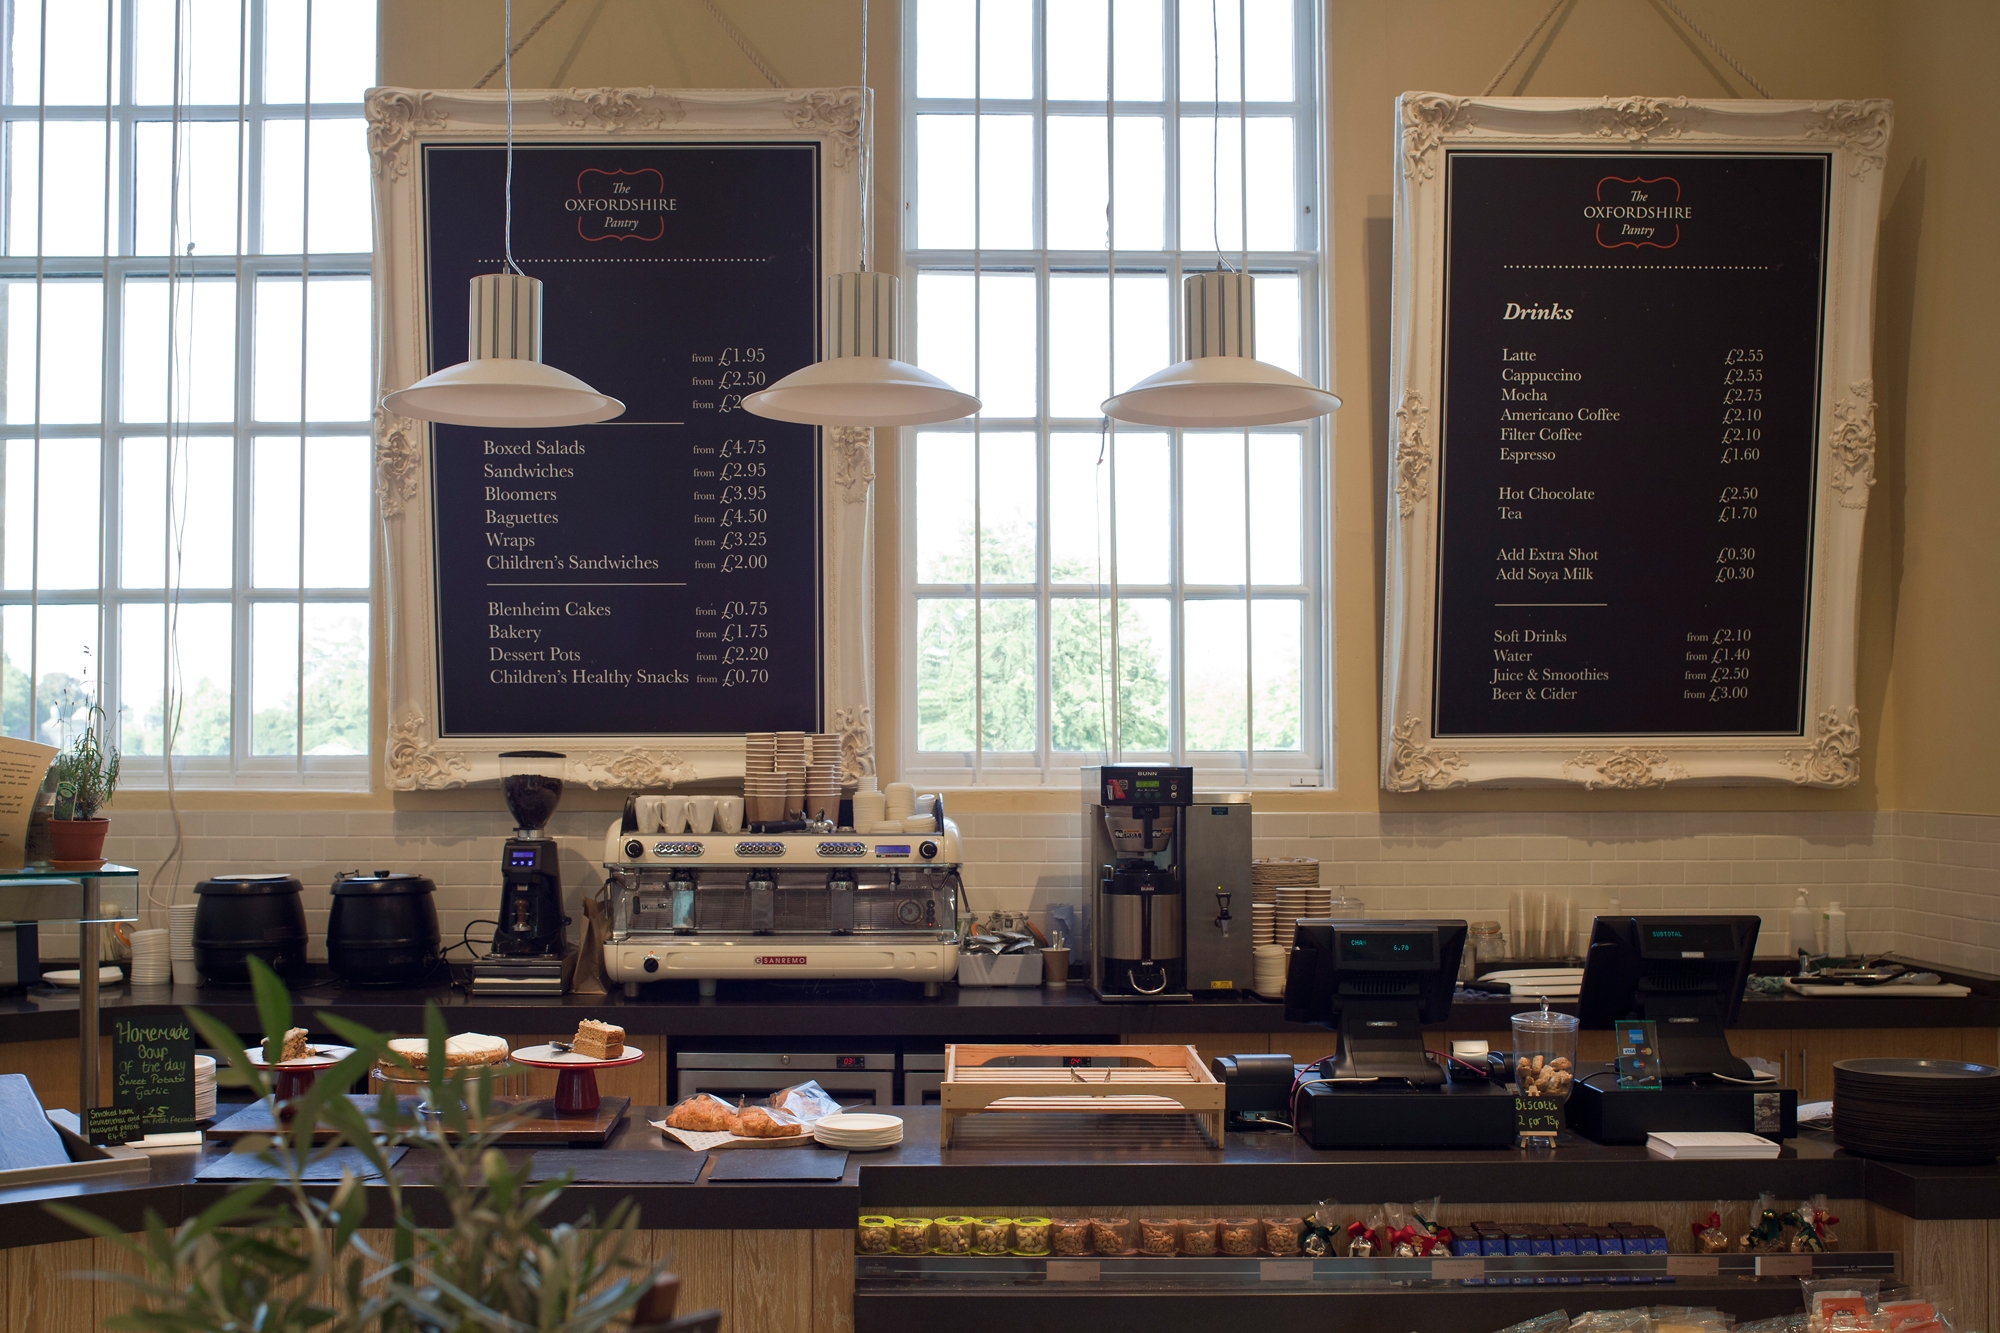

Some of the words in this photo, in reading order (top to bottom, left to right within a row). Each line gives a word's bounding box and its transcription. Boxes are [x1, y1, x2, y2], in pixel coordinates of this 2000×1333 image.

[613, 183, 630, 193] The
[1631, 191, 1648, 201] The
[565, 199, 676, 211] OXFORDSHIRE
[1584, 207, 1691, 218] OXFORDSHIRE
[604, 217, 638, 231] Pantry
[1622, 224, 1654, 238] Pantry
[1503, 303, 1574, 320] Drinks
[692, 354, 713, 362] from
[719, 348, 765, 366] £1.95
[1503, 349, 1536, 361] Latte
[1725, 349, 1763, 365] £2.55
[693, 377, 713, 385] from
[719, 371, 766, 390] £2.50
[1502, 368, 1581, 384] Cappuccino
[1724, 369, 1762, 384] £2.55
[693, 400, 713, 408] from
[1502, 388, 1547, 400] Mocha
[1723, 389, 1762, 404] £2.75
[1501, 408, 1573, 420] Americano
[1578, 408, 1620, 420] Coffee
[1723, 408, 1761, 424] £2.10
[1501, 428, 1535, 440] Filter
[1540, 428, 1582, 440] Coffee
[1722, 428, 1760, 444] £2.10
[484, 441, 531, 454] Boxed
[537, 440, 585, 454] Salads
[694, 445, 714, 453] from
[720, 440, 765, 457] £4.75
[1501, 448, 1555, 464] Espresso
[1721, 448, 1759, 463] £1.60
[485, 464, 573, 477] Sandwiches
[694, 468, 714, 476] from
[720, 463, 766, 480] £2.95
[485, 487, 556, 500] Bloomers
[694, 492, 714, 500] from
[720, 486, 766, 503] £3.95
[1499, 487, 1524, 499] Hot
[1529, 487, 1594, 499] Chocolate
[1719, 487, 1758, 502] £2.50
[486, 510, 558, 527] Baguettes
[720, 509, 766, 526] £4.50
[1498, 507, 1522, 519] Tea
[1718, 507, 1757, 522] £1.70
[486, 533, 535, 551] Wraps
[695, 537, 715, 545] from
[721, 532, 766, 549] £3.25
[487, 555, 564, 569] Children's
[570, 555, 658, 569] Sandwiches
[695, 560, 715, 568] from
[721, 555, 767, 572] £2.00
[1497, 548, 1524, 560] Add
[1529, 548, 1564, 560] Extra
[1569, 548, 1598, 560] Shot
[1717, 548, 1755, 563] £0.30
[1496, 568, 1523, 580] Add
[1528, 568, 1559, 583] Soya
[1564, 568, 1593, 579] Milk
[1715, 567, 1754, 582] £0.30
[489, 602, 560, 615] Blenheim
[566, 602, 610, 615] Cakes
[696, 607, 716, 615] from
[722, 602, 767, 619] £0.75
[489, 625, 541, 642] Bakery
[696, 630, 716, 638] from
[722, 624, 767, 641] £1.75
[1495, 630, 1519, 642] Soft
[1525, 630, 1566, 642] Drinks
[1687, 632, 1708, 641] from
[1712, 629, 1751, 644] £2.10
[490, 647, 545, 661] Dessert
[550, 647, 580, 661] Pots
[697, 652, 717, 660] from
[722, 647, 768, 664] £2.20
[1494, 650, 1532, 661] Water
[1686, 652, 1707, 660] from
[1711, 648, 1750, 663] £1.40
[490, 670, 567, 683] Children's
[573, 670, 632, 687] Healthy
[638, 670, 689, 683] Snacks
[723, 669, 768, 686] £0.70
[1490, 669, 1523, 684] Juice
[1528, 669, 1538, 680] &
[1543, 668, 1608, 680] Smoothies
[1685, 671, 1706, 679] from
[1710, 668, 1749, 683] £2.50
[1493, 688, 1522, 700] Beer
[1526, 688, 1536, 700] &
[1541, 688, 1577, 699] Cider
[1684, 690, 1705, 698] from
[1709, 687, 1748, 702] £3.00
[142, 1061, 160, 1073] the
[165, 1058, 186, 1077] day
[150, 1075, 185, 1084] Potato
[135, 1087, 169, 1100] Garlic
[1515, 1098, 1558, 1110] Biscotti
[1518, 1115, 1525, 1125] 2
[1528, 1117, 1541, 1128] for
[1544, 1116, 1559, 1129] 75p
